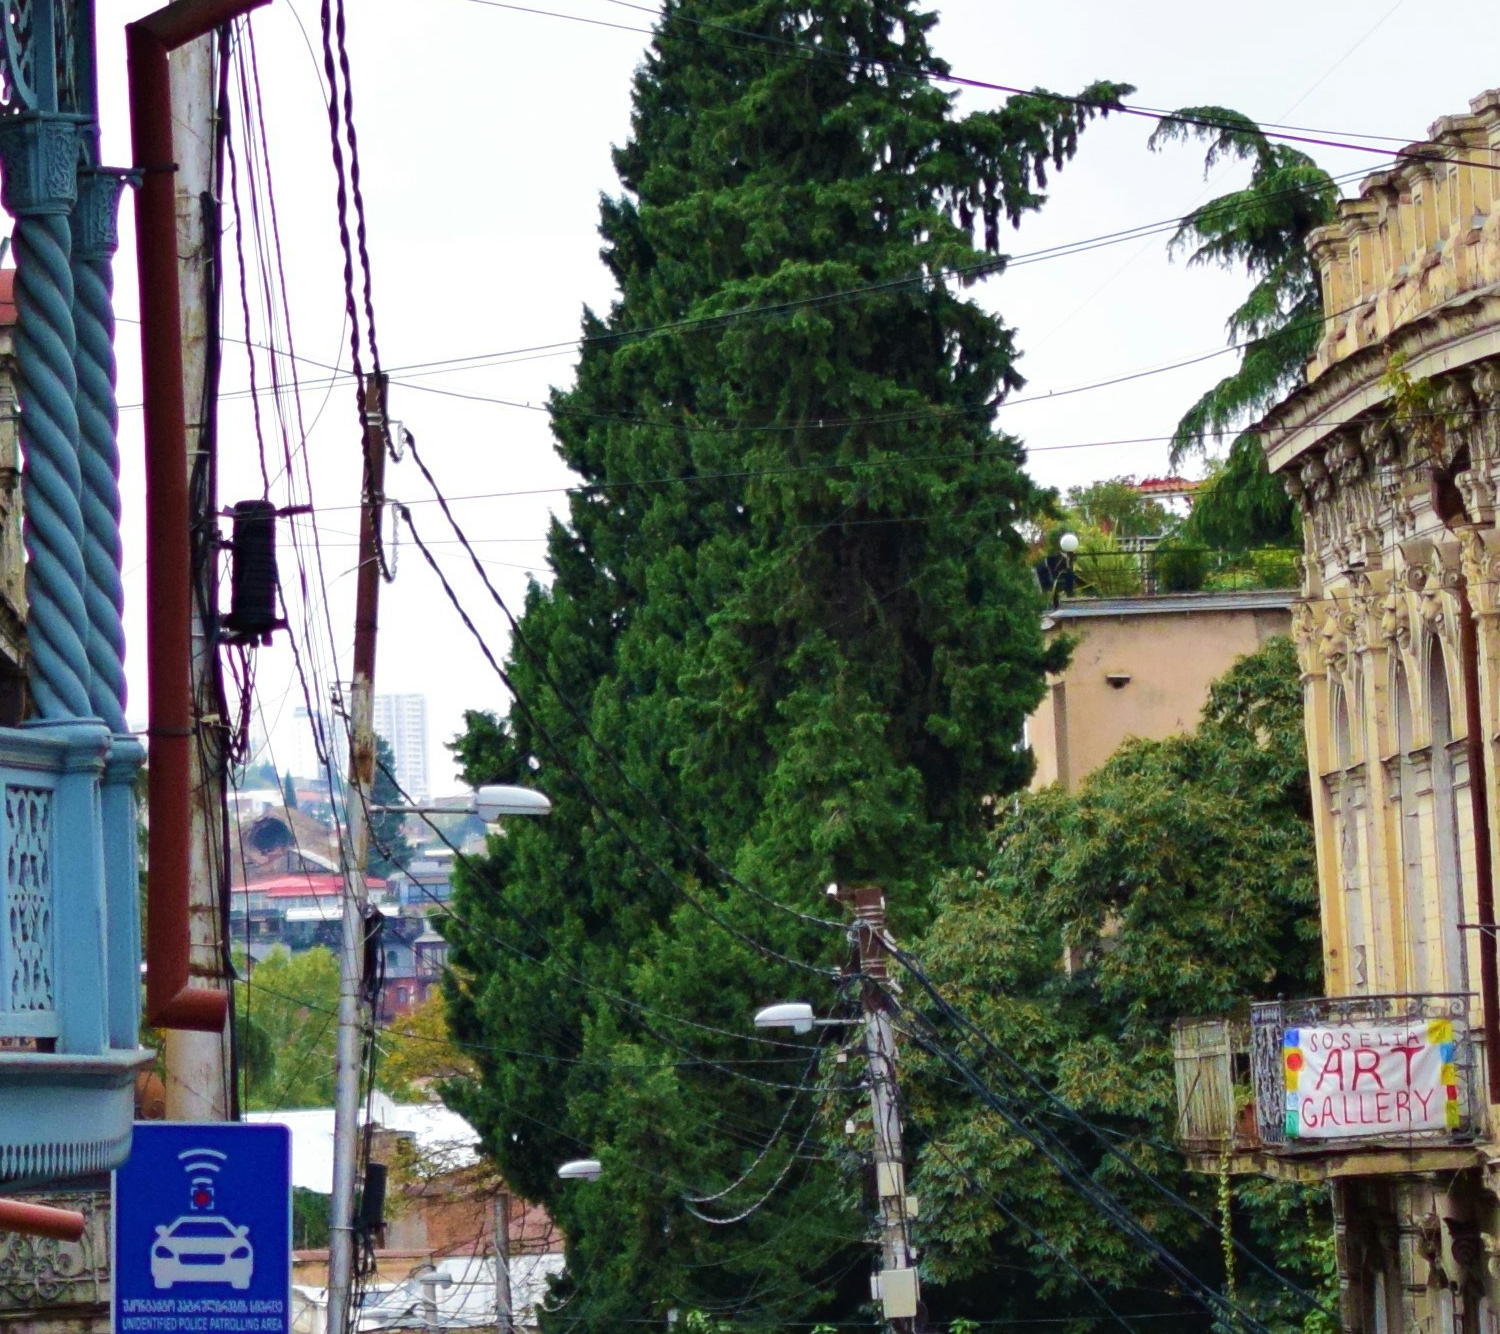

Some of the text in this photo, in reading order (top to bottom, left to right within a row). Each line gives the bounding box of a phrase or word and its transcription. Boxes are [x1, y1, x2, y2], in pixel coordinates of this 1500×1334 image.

[1310, 1031, 1420, 1053] SOSELIA
[1315, 1045, 1425, 1091] ART
[1301, 1089, 1434, 1128] GALLERY
[122, 1317, 283, 1331] UNIDENTIFIED POLICE PATROLLING AREA
